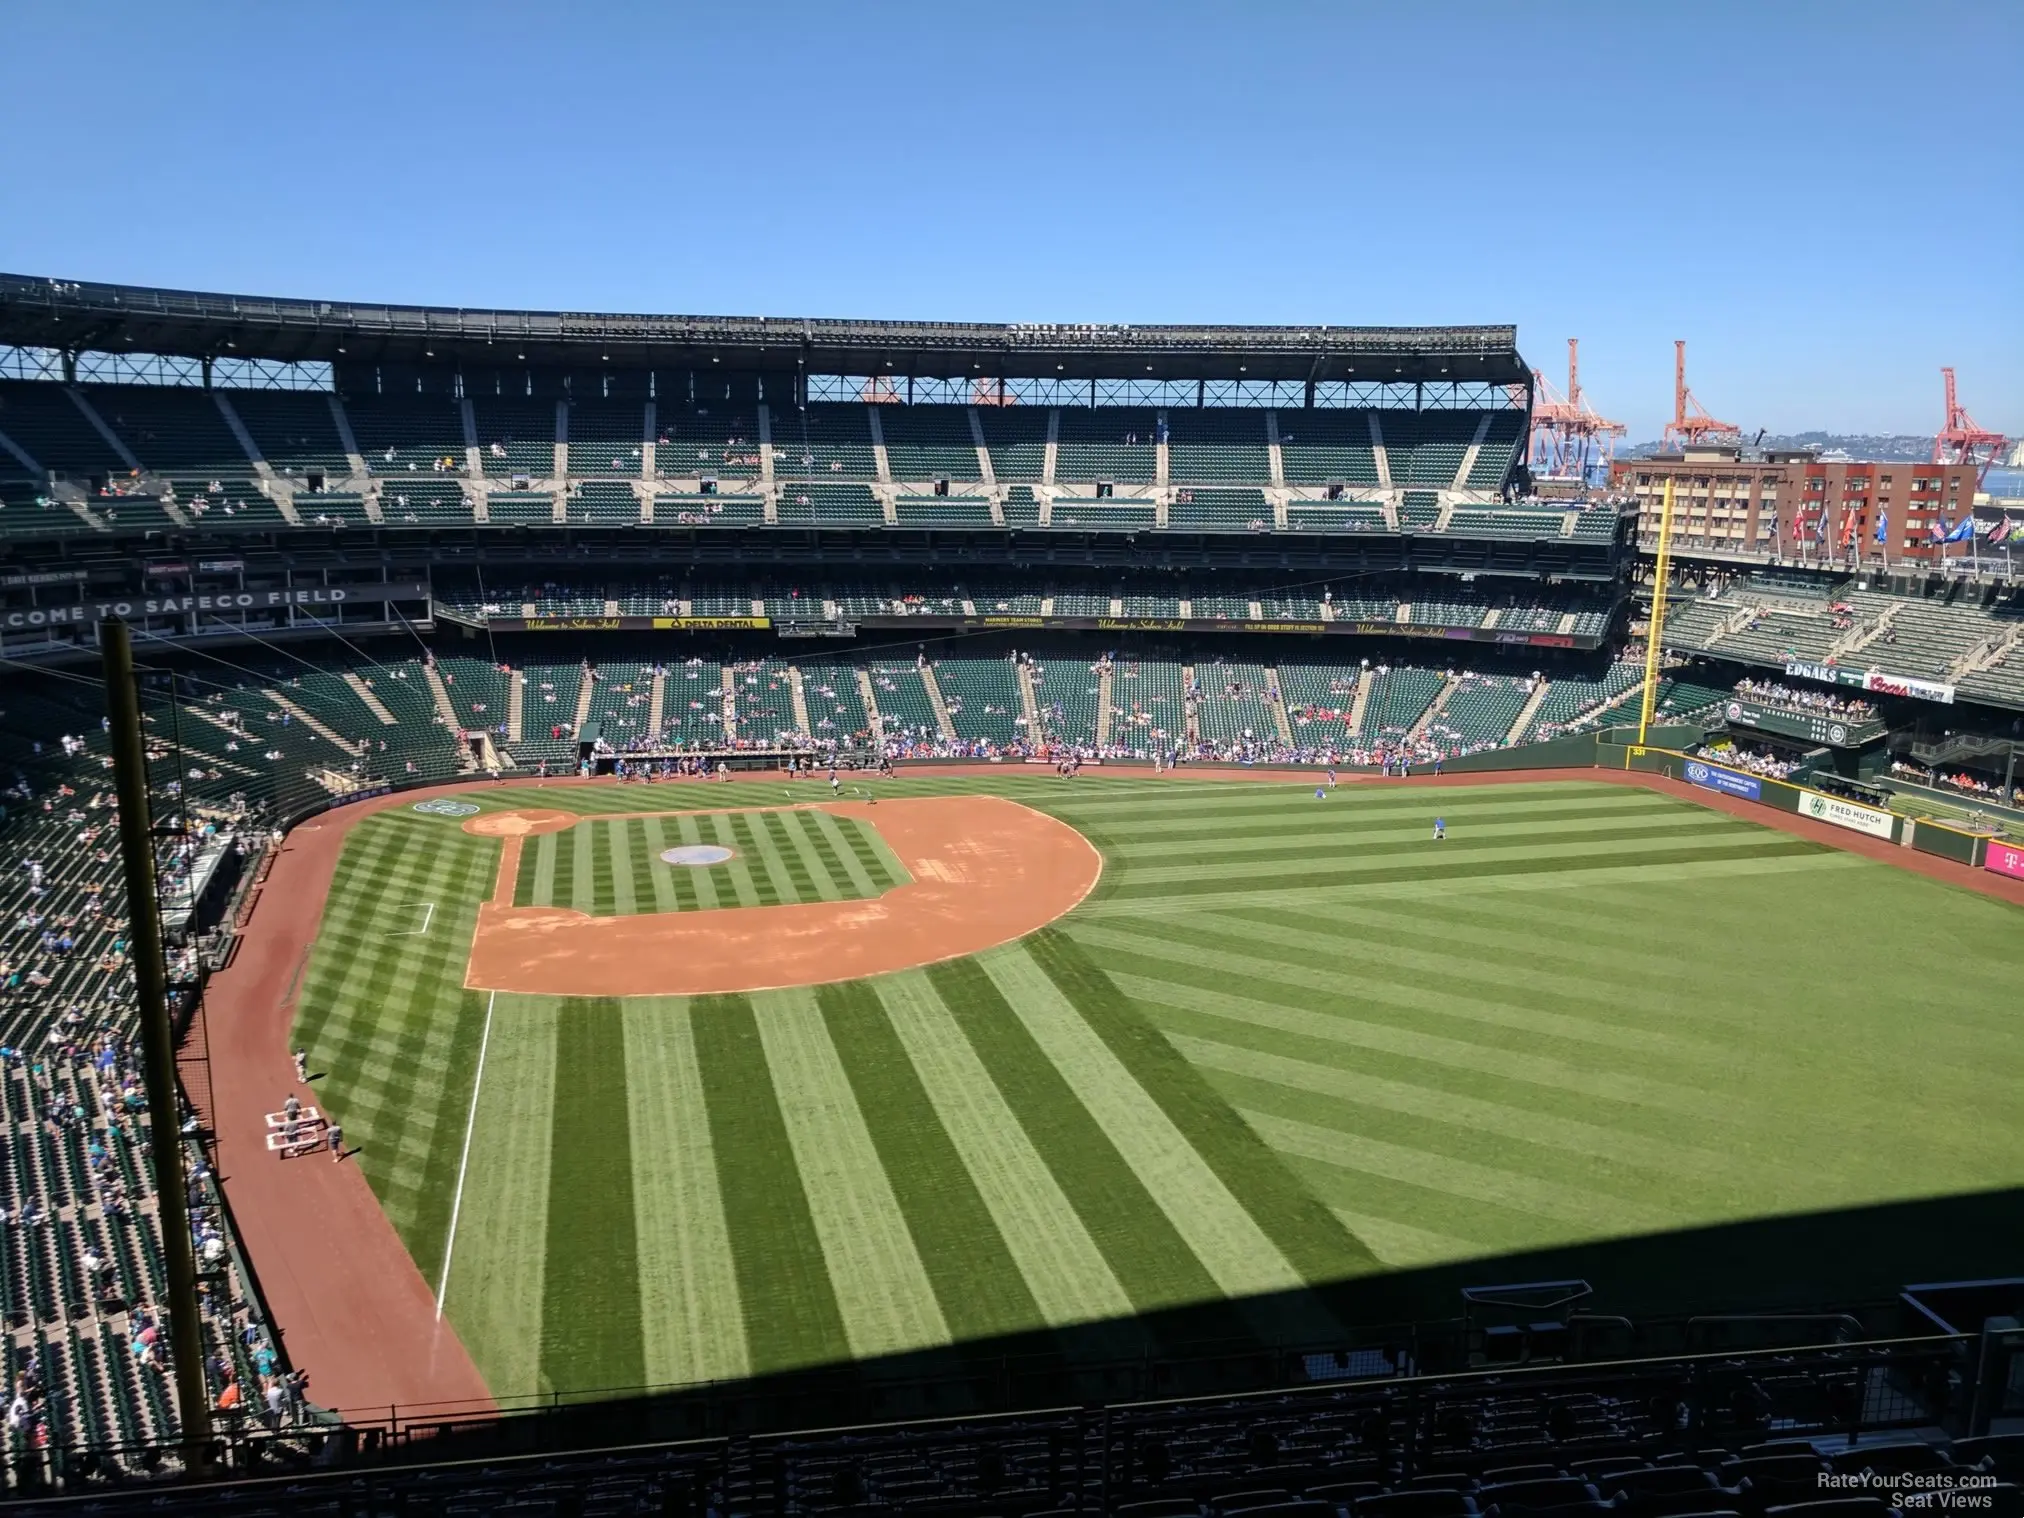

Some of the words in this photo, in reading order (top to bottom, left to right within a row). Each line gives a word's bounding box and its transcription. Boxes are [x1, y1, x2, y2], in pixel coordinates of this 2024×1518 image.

[96, 602, 132, 617] TO
[146, 594, 254, 613] SAFECO
[268, 589, 346, 604] FIELD
[525, 619, 559, 630] Welcome
[561, 622, 568, 630] to
[569, 619, 596, 630] Safeco
[597, 619, 620, 630] Field
[685, 620, 714, 629] DELTA
[717, 620, 755, 629] DENTAL
[1098, 620, 1128, 629] Welcome
[1137, 620, 1161, 629] Safeco
[1163, 620, 1185, 630] Field
[1356, 624, 1387, 634] Welcome
[1388, 627, 1396, 635] to
[1397, 625, 1423, 637] Safeco
[1424, 627, 1446, 638] Field
[1870, 676, 1908, 696] Coors
[1831, 804, 1851, 816] FRED
[1853, 811, 1882, 824] HUTCH
